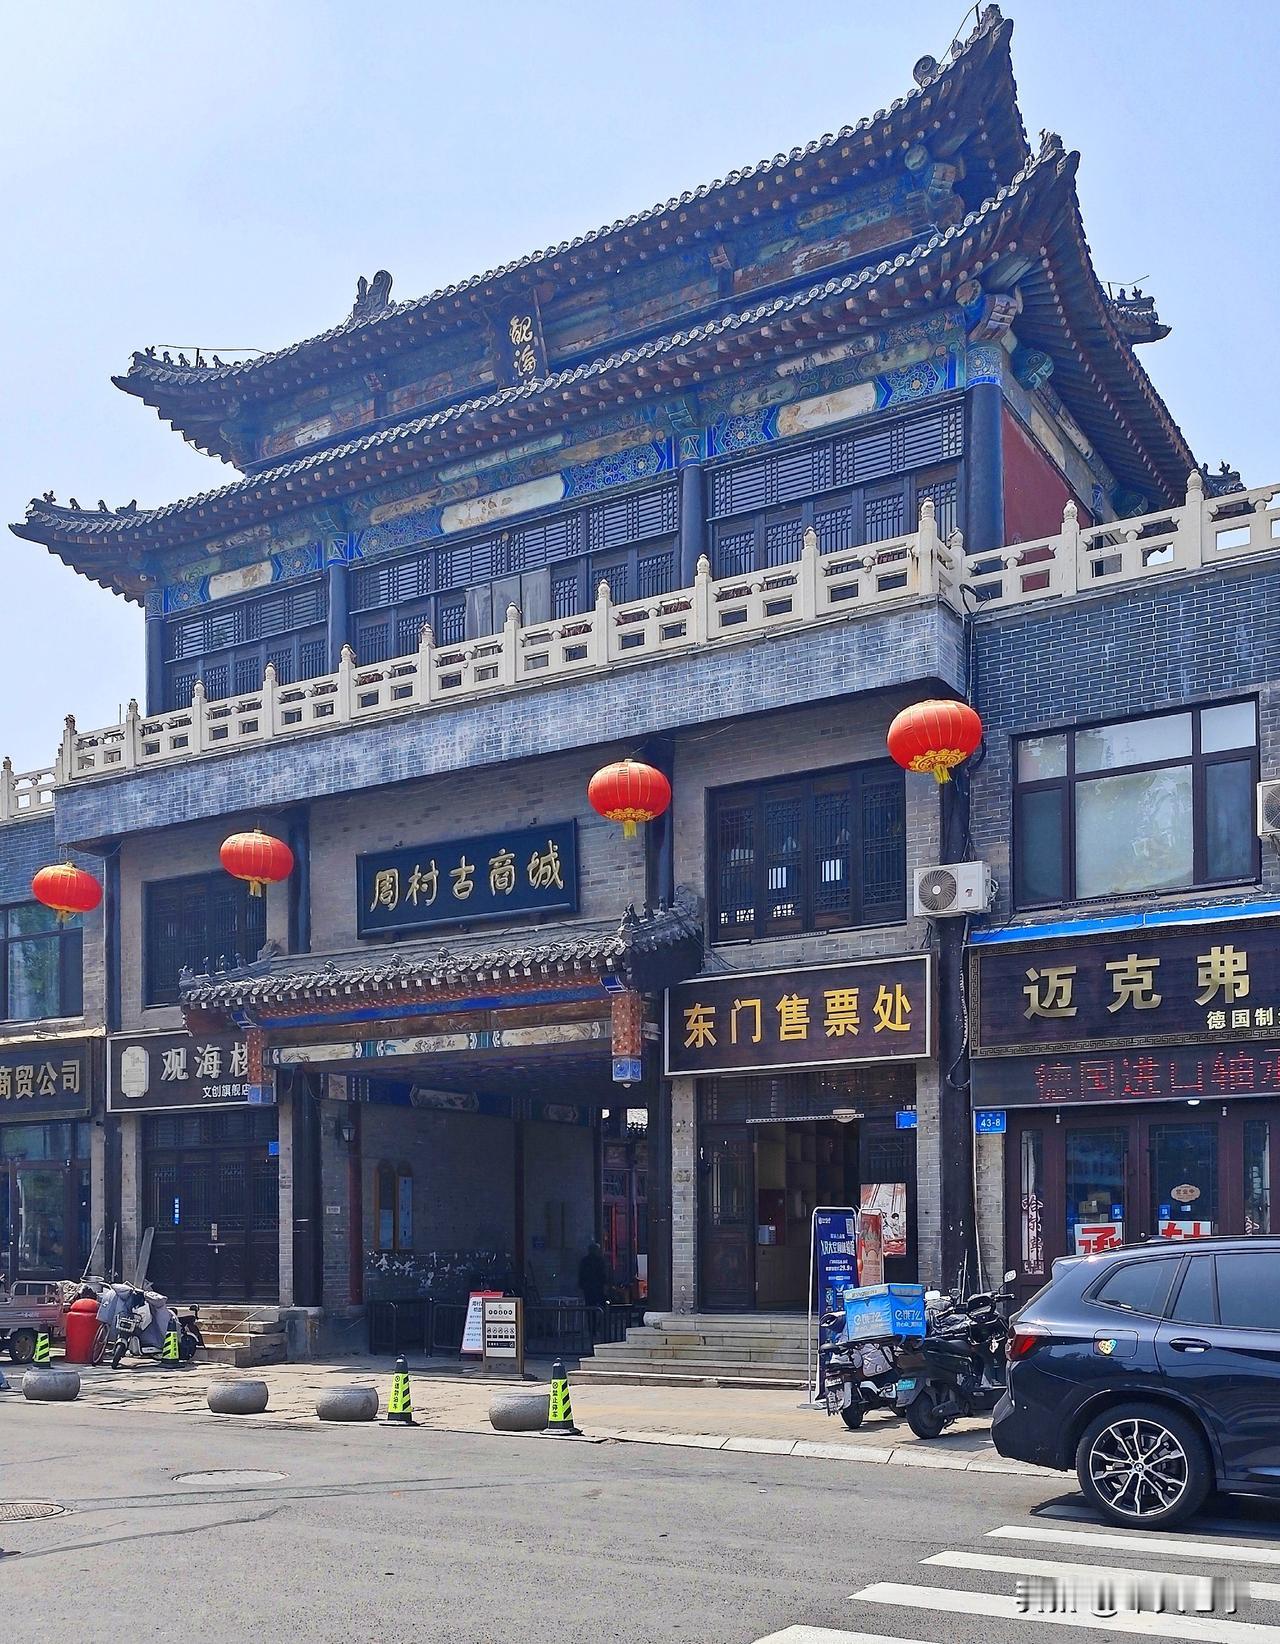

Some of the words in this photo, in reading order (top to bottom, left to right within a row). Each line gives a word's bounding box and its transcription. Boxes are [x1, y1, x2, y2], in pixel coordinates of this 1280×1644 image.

[369, 840, 564, 912] 周村古商城
[1022, 945, 1250, 1021] 迈克弗
[683, 984, 912, 1048] 东门售票处
[1206, 1007, 1280, 1030] 德国制
[202, 1083, 250, 1099] 文创旗舰店
[980, 1118, 1001, 1128] 43-8
